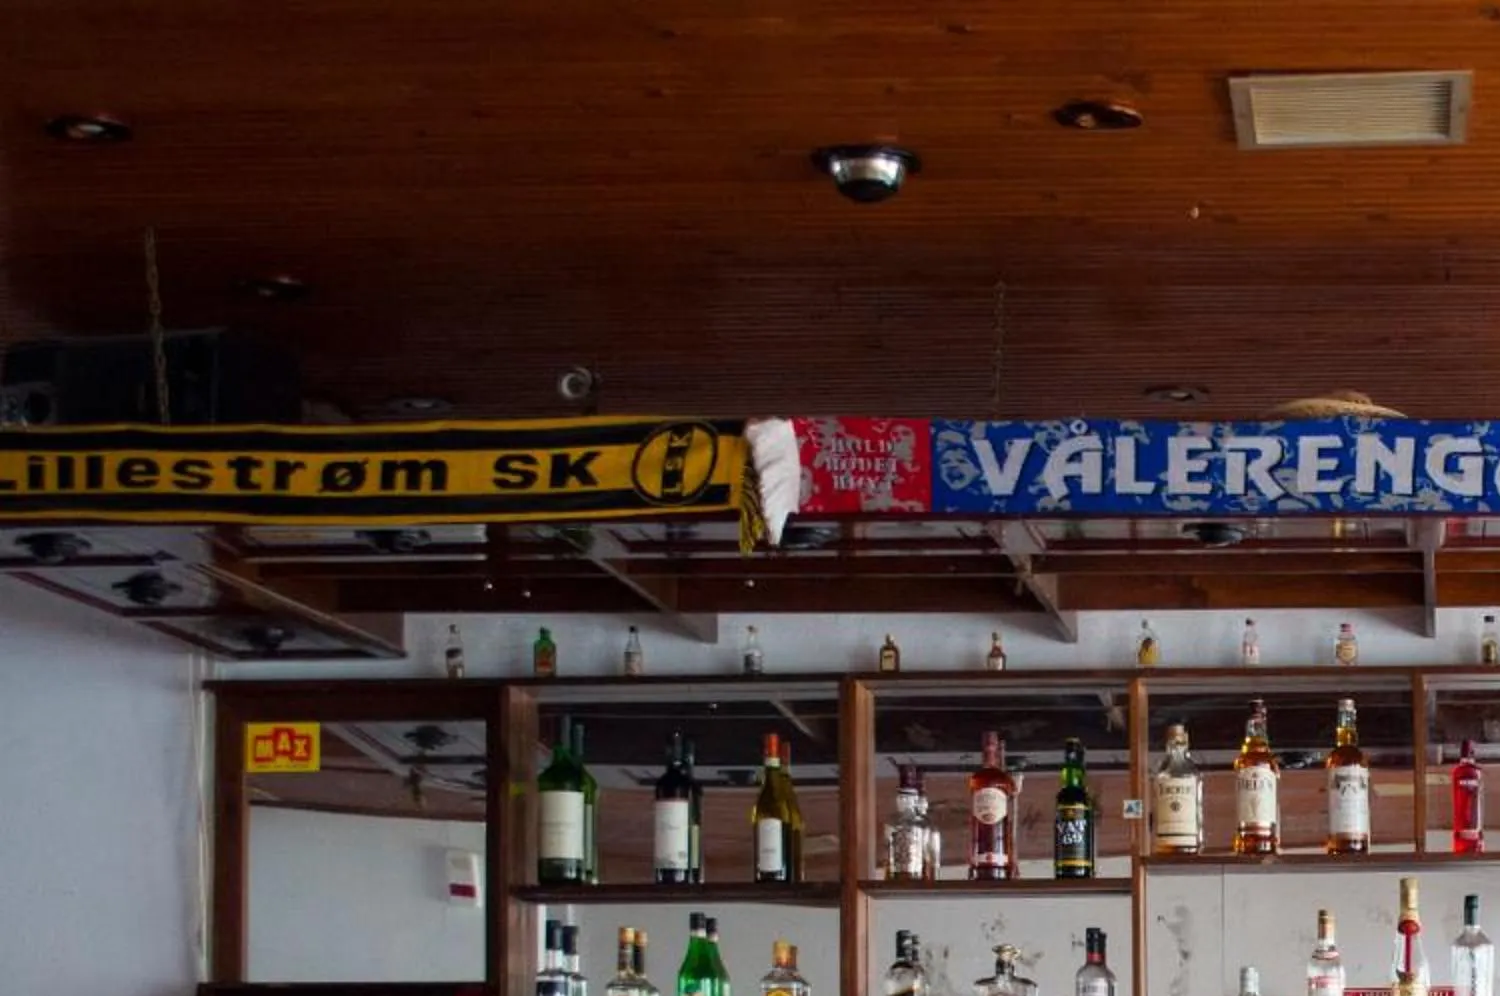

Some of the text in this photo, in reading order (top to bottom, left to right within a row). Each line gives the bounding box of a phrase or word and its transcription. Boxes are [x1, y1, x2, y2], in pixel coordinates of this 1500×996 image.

[0, 451, 600, 492] illestrøm SK
[1057, 819, 1086, 834] VAT
[1064, 833, 1084, 845] 69
